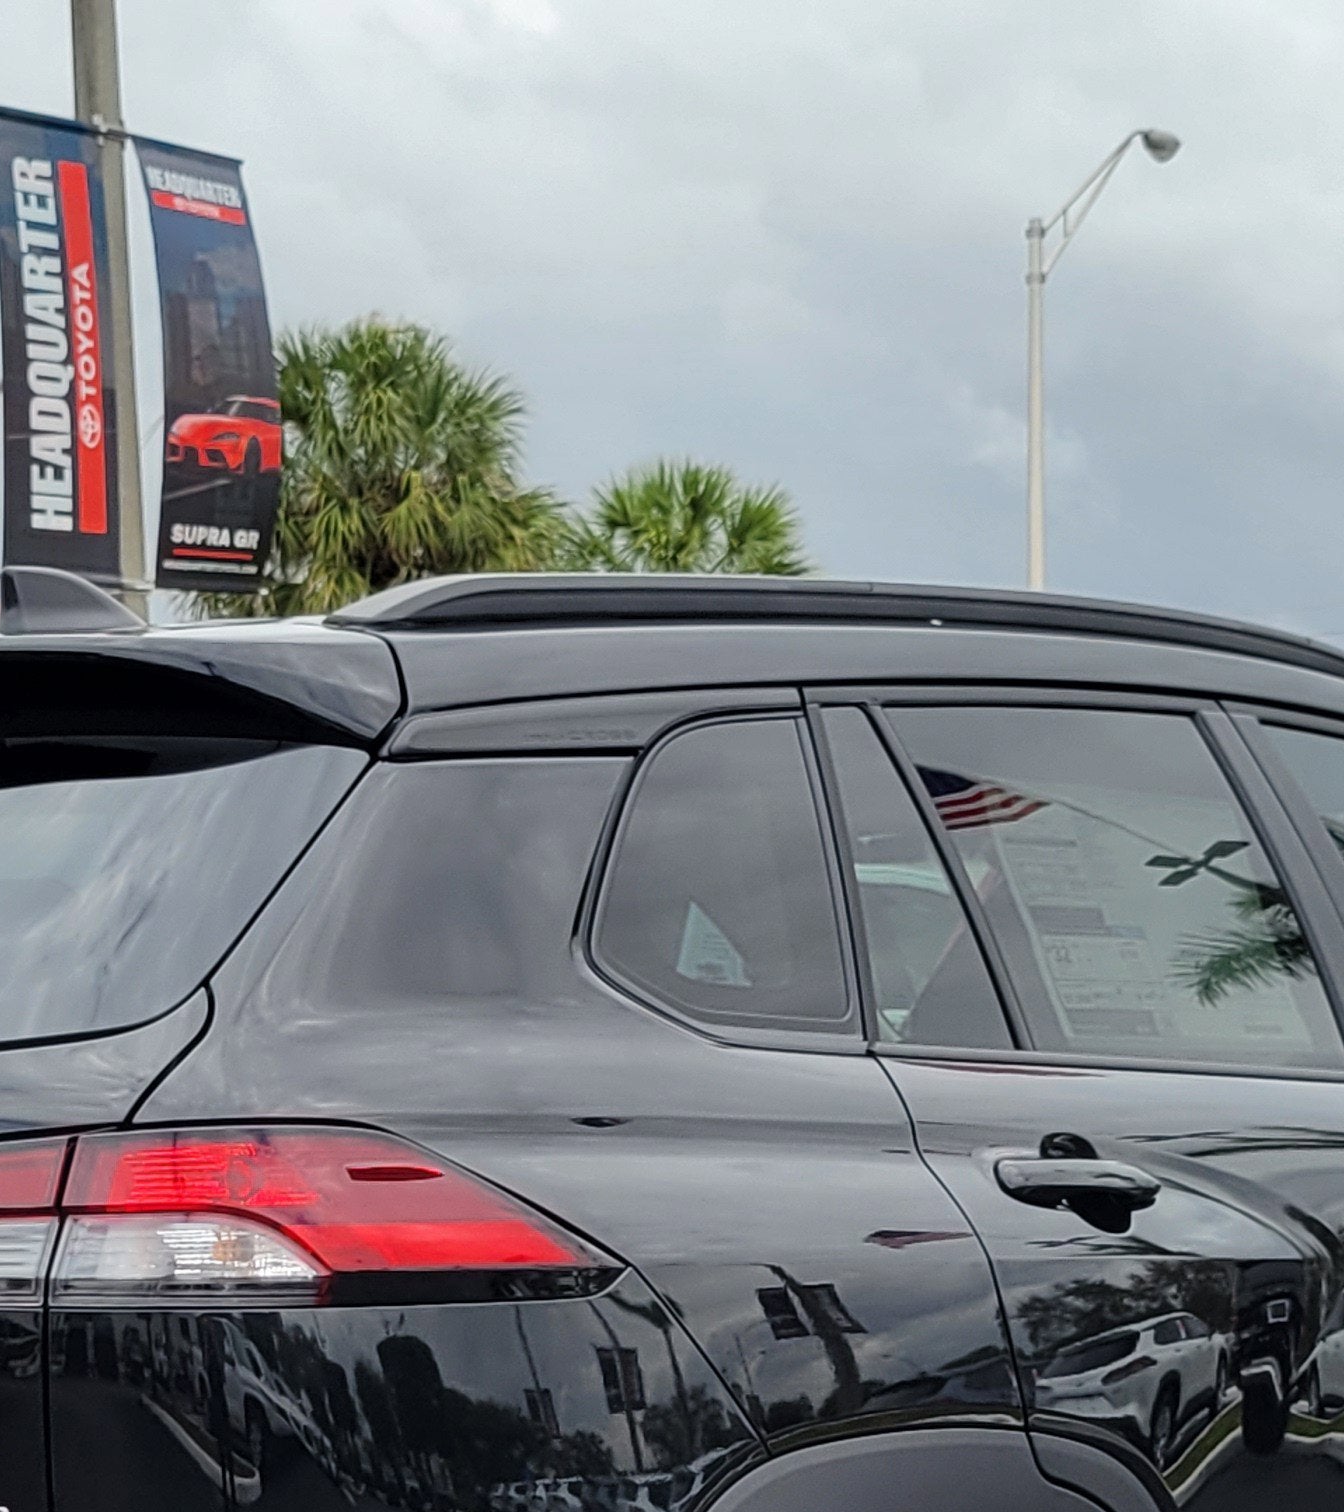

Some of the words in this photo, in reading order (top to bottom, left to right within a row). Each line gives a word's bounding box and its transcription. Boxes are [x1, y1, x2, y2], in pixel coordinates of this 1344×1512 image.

[11, 155, 74, 532] HEADQUARTER
[71, 262, 97, 401] TOYOTA
[170, 523, 231, 547] SUPRA
[233, 529, 260, 550] GR
